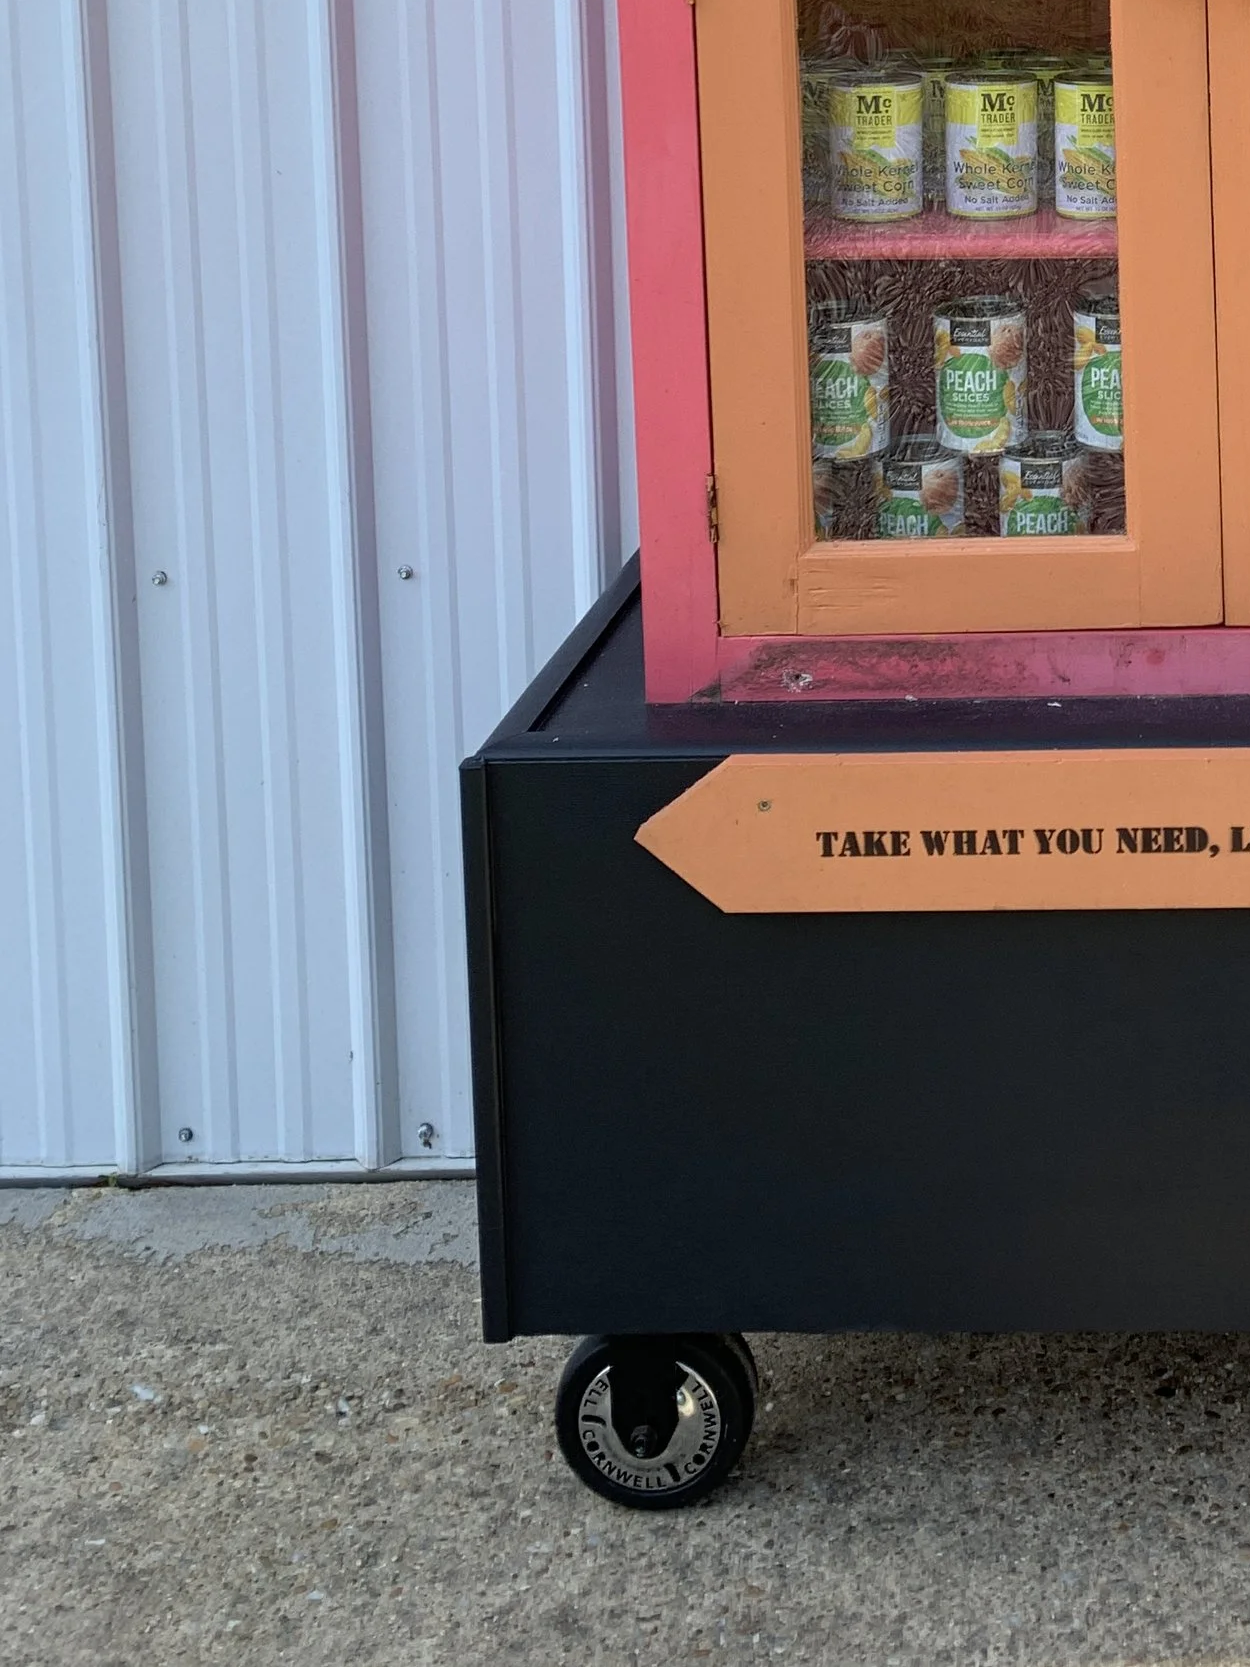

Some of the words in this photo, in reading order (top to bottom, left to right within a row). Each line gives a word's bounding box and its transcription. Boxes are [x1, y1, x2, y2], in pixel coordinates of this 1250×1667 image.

[857, 115, 892, 125] TRADER
[981, 113, 1015, 123] TRADER
[953, 161, 996, 175] Whole
[1058, 161, 1096, 175] Whole
[883, 179, 914, 194] Corn
[958, 178, 1001, 190] Sweet
[1062, 178, 1100, 191] Sweet
[856, 198, 874, 207] Salt
[964, 195, 977, 204] No
[981, 195, 998, 204] Salt
[1067, 195, 1077, 203] No
[1081, 195, 1098, 204] Salt
[946, 370, 997, 392] PEACH
[1091, 368, 1120, 390] PEA
[952, 392, 990, 402] SLICES
[1098, 391, 1120, 401] SLIC
[881, 513, 928, 534] PEACH
[1017, 511, 1068, 534] PEACH
[815, 830, 911, 858] TAKE
[919, 829, 1025, 857] WHAT
[1033, 828, 1105, 855] YOU
[1115, 826, 1220, 858] NEED,
[684, 1380, 718, 1475] CORNWELL
[582, 1429, 668, 1489] CORNWELL
